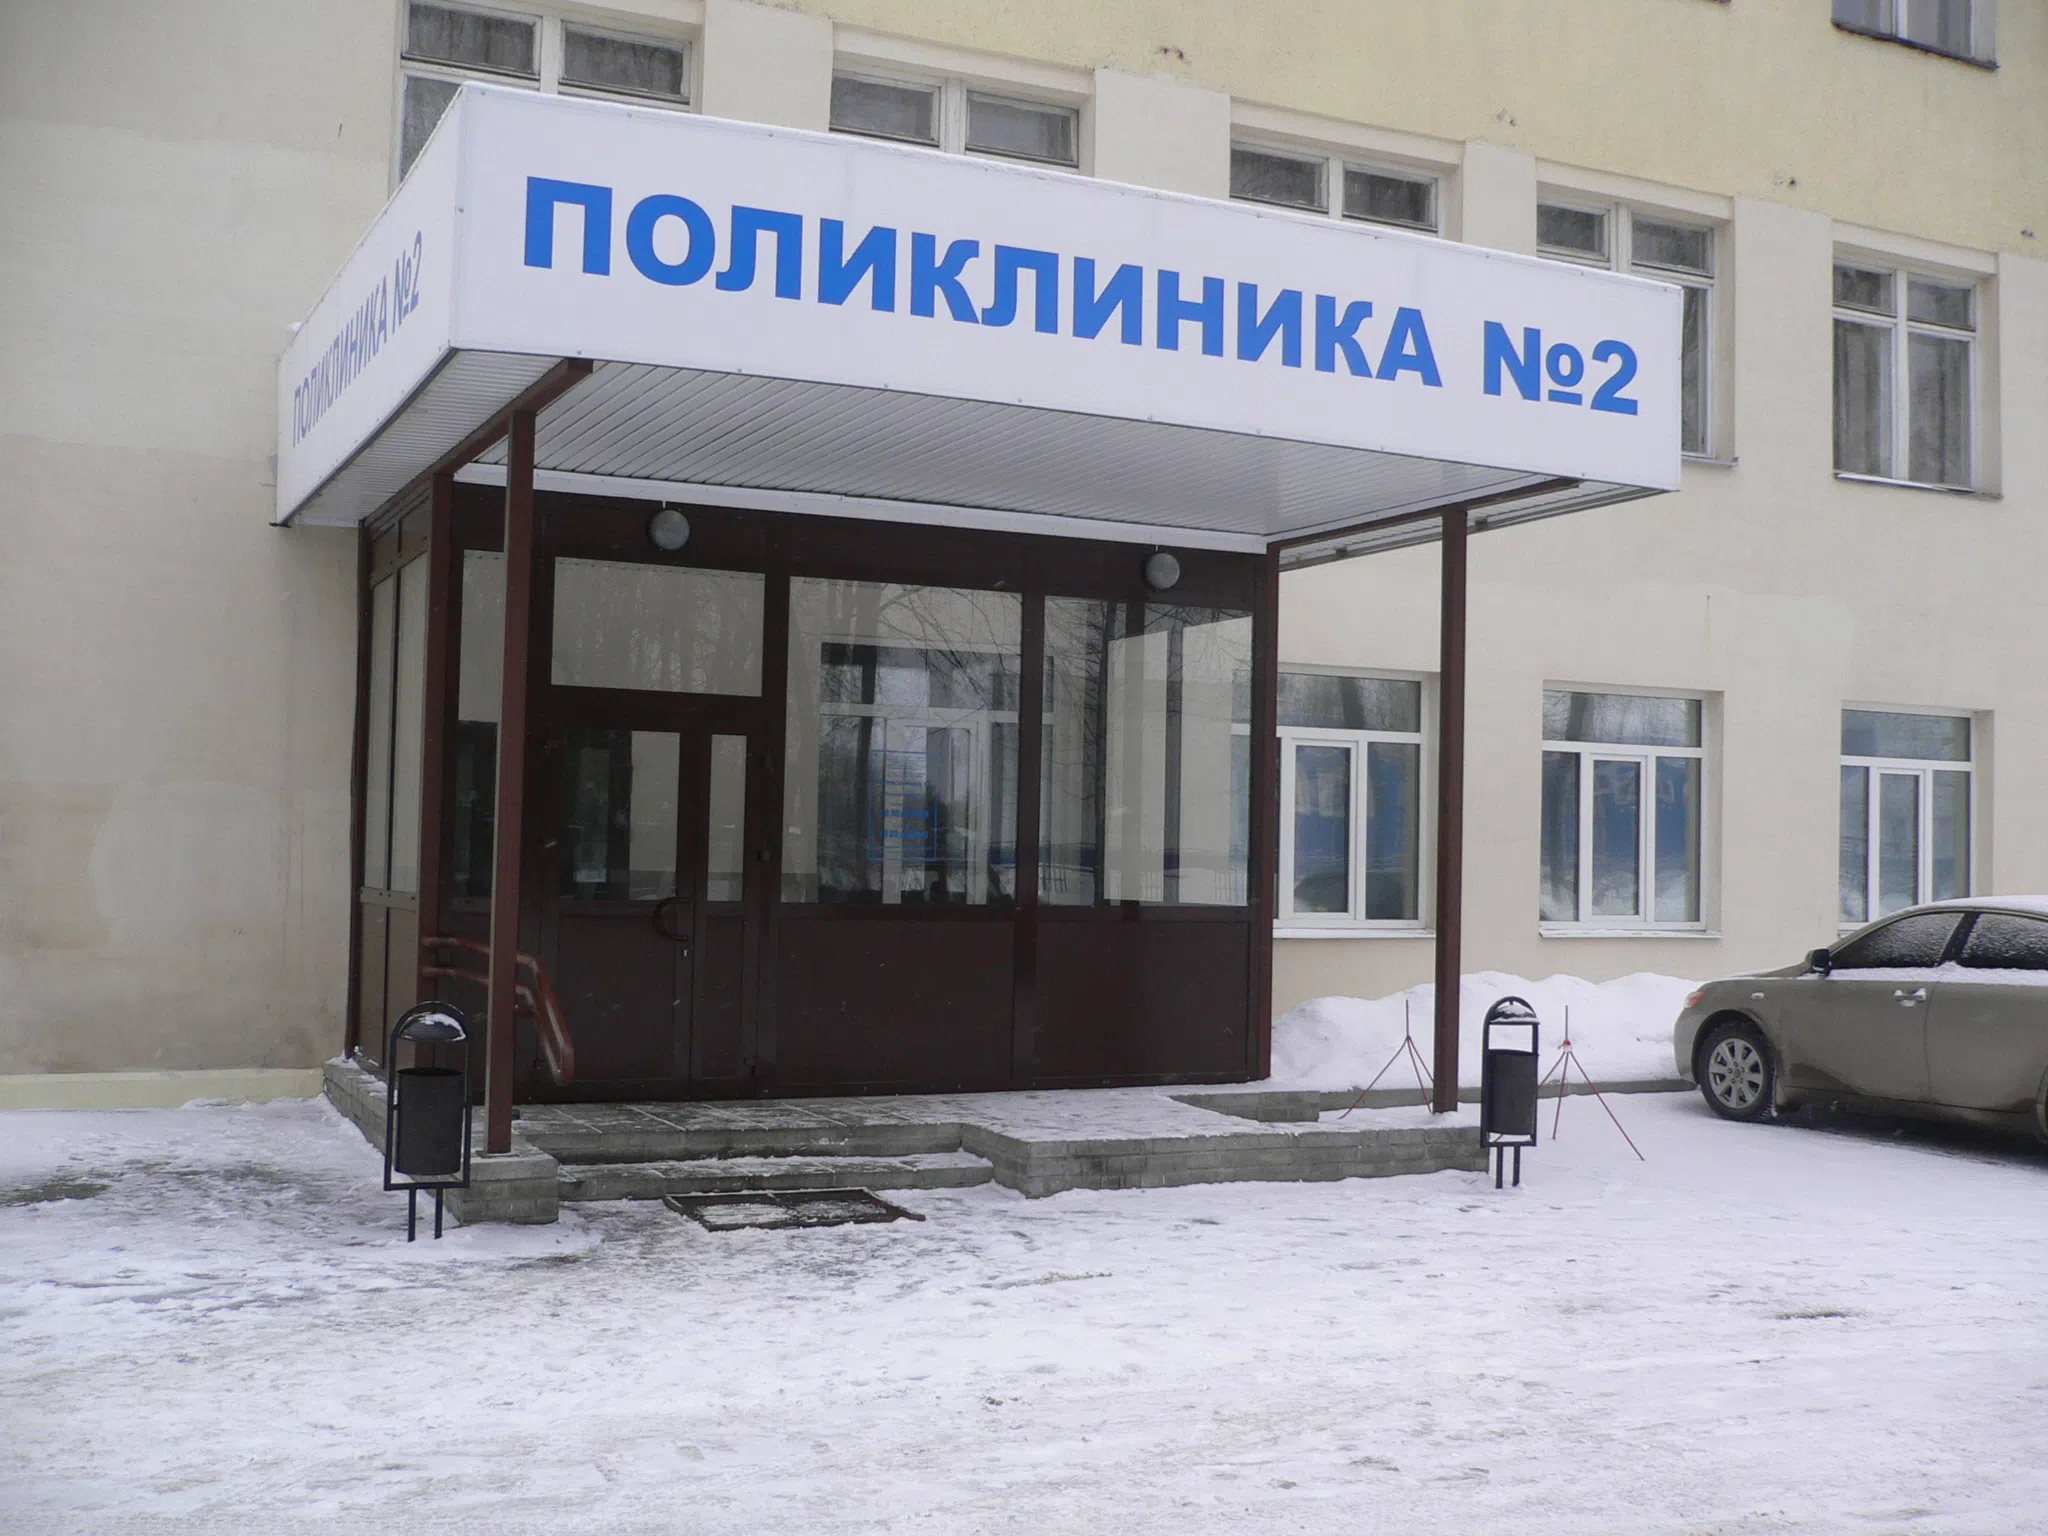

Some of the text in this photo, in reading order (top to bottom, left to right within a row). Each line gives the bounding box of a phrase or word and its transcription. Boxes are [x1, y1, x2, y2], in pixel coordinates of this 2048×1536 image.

[292, 229, 423, 449] ПОЛИКЛИНИКА №2
[525, 176, 1639, 416] ПОЛИКЛИНИКА №2
